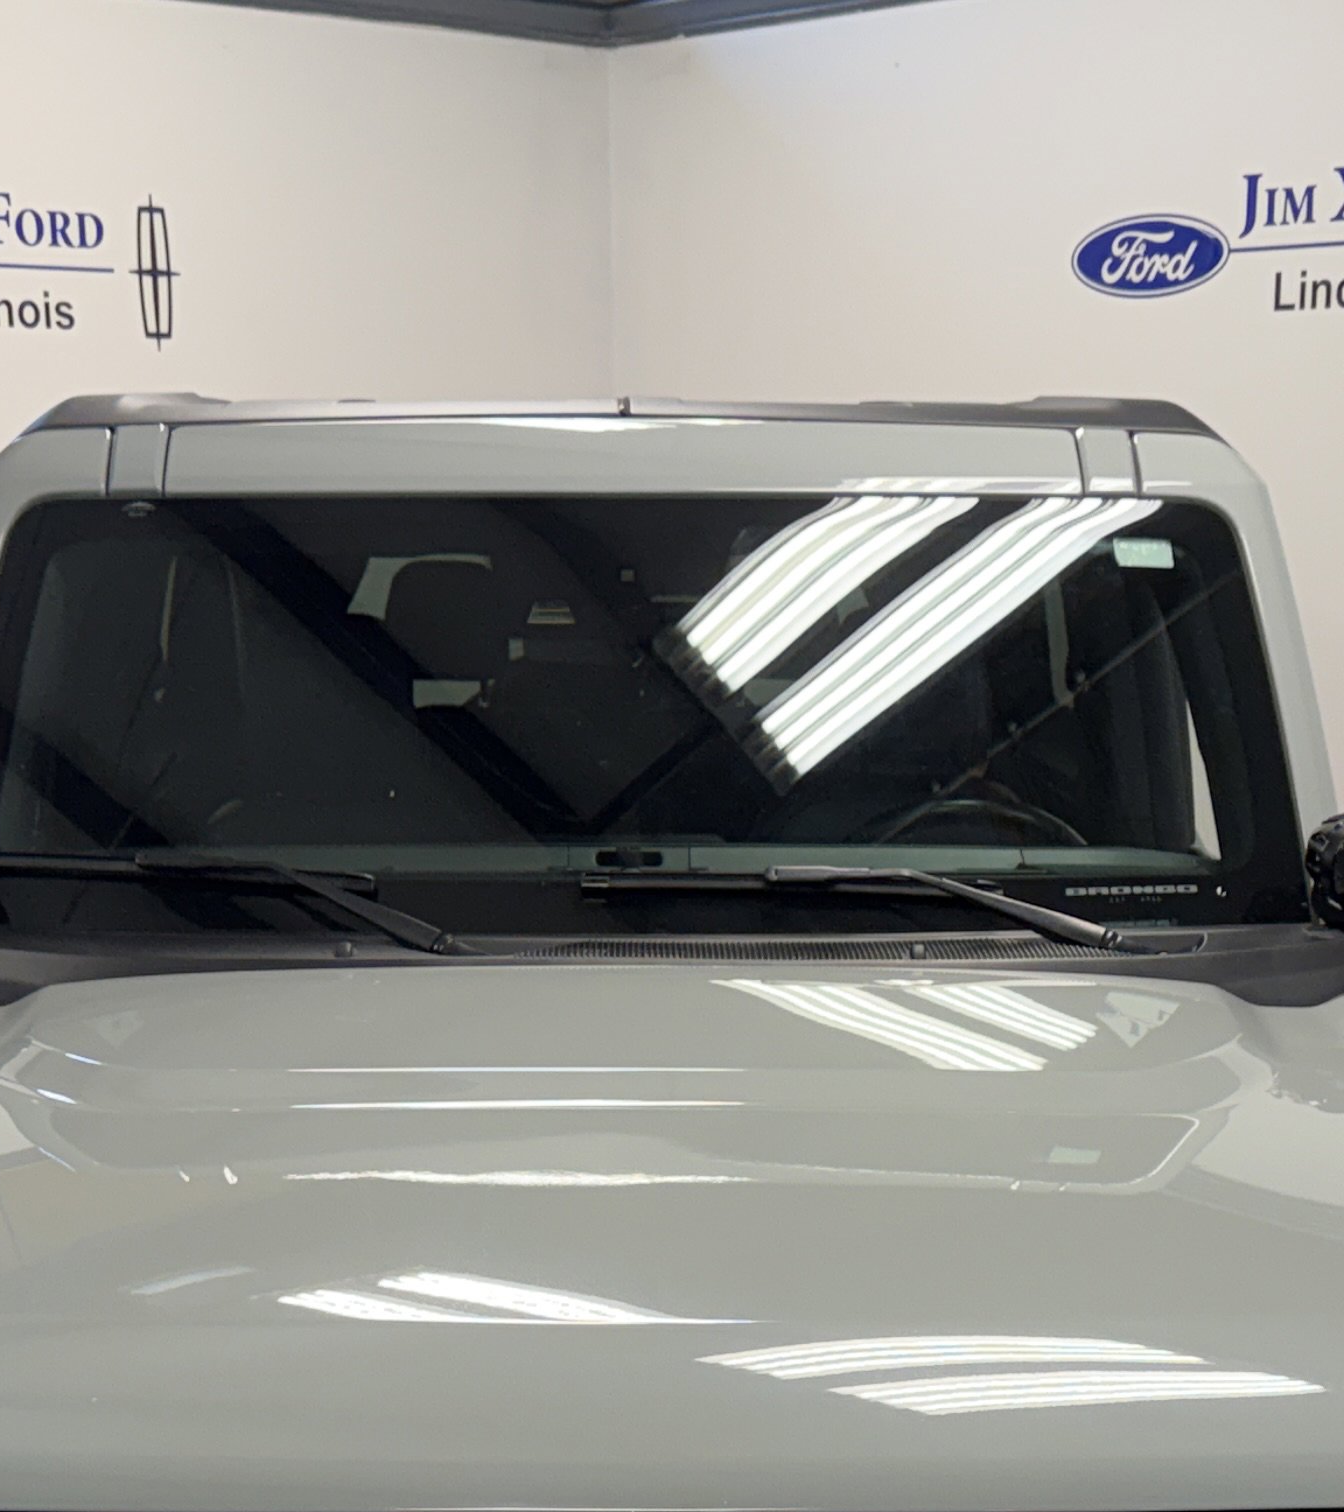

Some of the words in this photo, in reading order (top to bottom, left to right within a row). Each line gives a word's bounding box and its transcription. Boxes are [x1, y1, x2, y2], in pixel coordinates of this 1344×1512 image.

[1239, 174, 1316, 239] JIM
[1100, 229, 1194, 285] Ford
[1065, 884, 1198, 897] BRONCO
